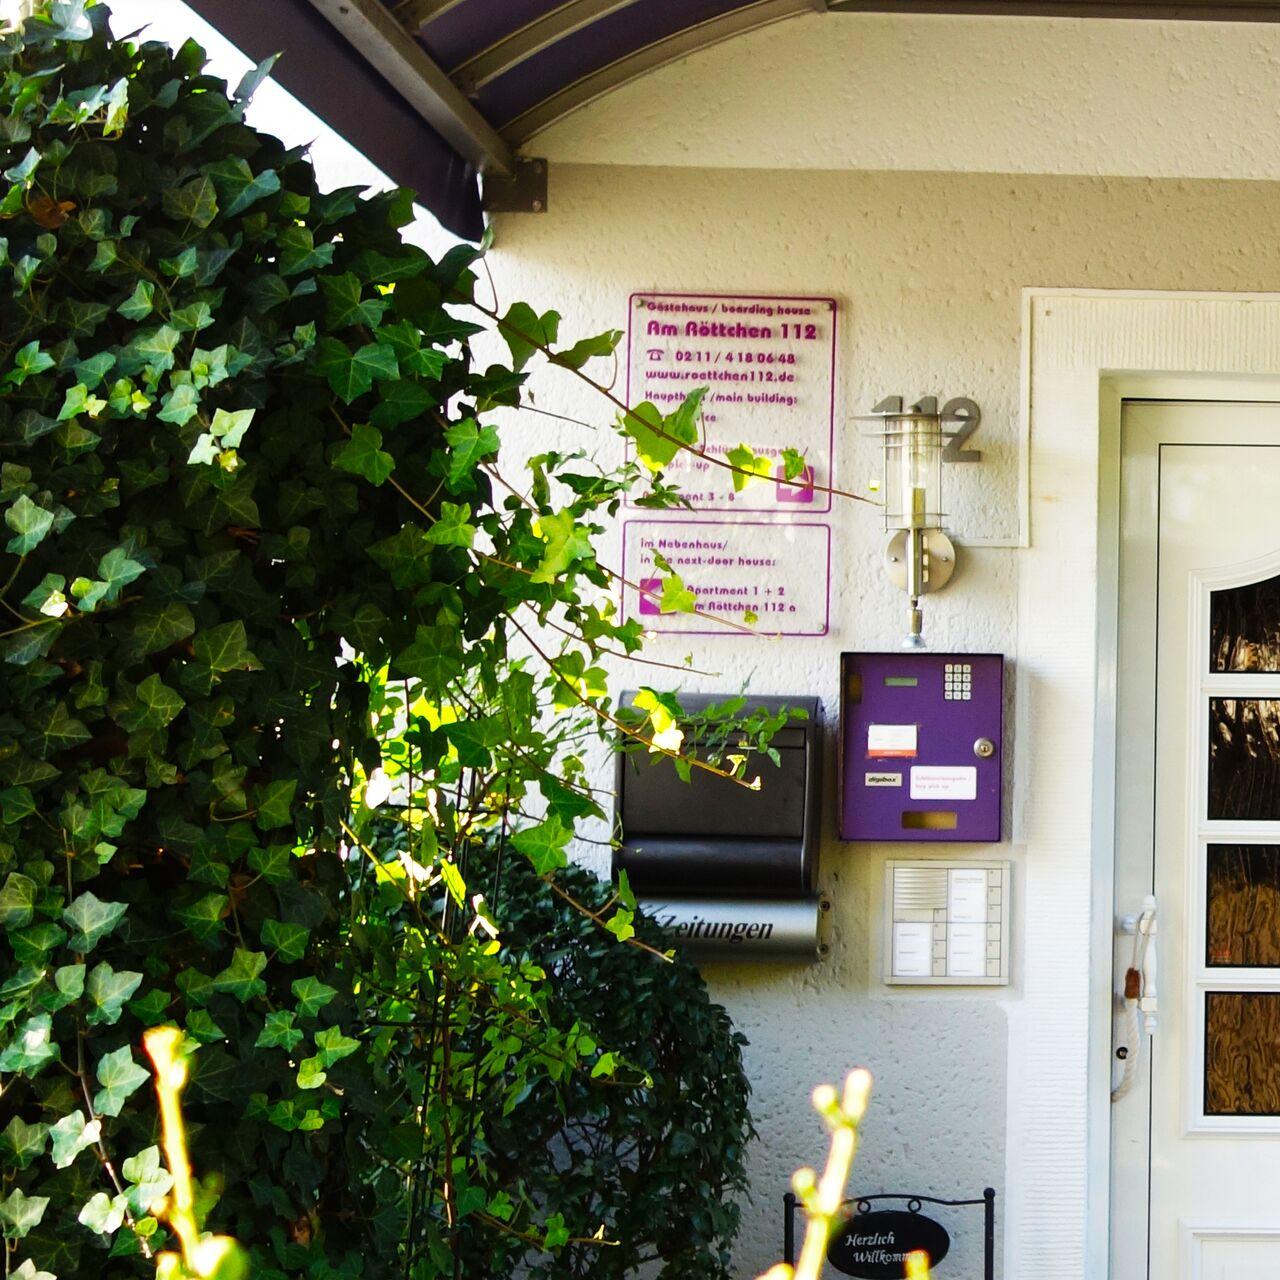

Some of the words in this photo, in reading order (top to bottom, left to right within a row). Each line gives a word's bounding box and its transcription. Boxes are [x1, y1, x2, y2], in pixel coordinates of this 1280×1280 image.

[711, 303, 718, 313] /
[721, 303, 773, 317] boarding
[777, 305, 811, 316] house
[647, 321, 678, 336] Am
[685, 321, 772, 338] Röttchen
[781, 323, 817, 340] 112
[645, 369, 795, 383] www.roettchen112.de
[747, 393, 798, 406] building:
[708, 492, 715, 501] 3
[728, 492, 735, 502] 8
[640, 538, 654, 548] im
[640, 556, 650, 564] in
[677, 556, 734, 566] next-door
[738, 557, 776, 567] house:
[686, 585, 748, 596] Apartment
[753, 586, 758, 595] 1
[777, 587, 785, 596] 2
[708, 601, 759, 612] Röttchen
[764, 602, 785, 612] 112
[660, 915, 774, 944] Zeitungen
[845, 1231, 895, 1247] Herzlich
